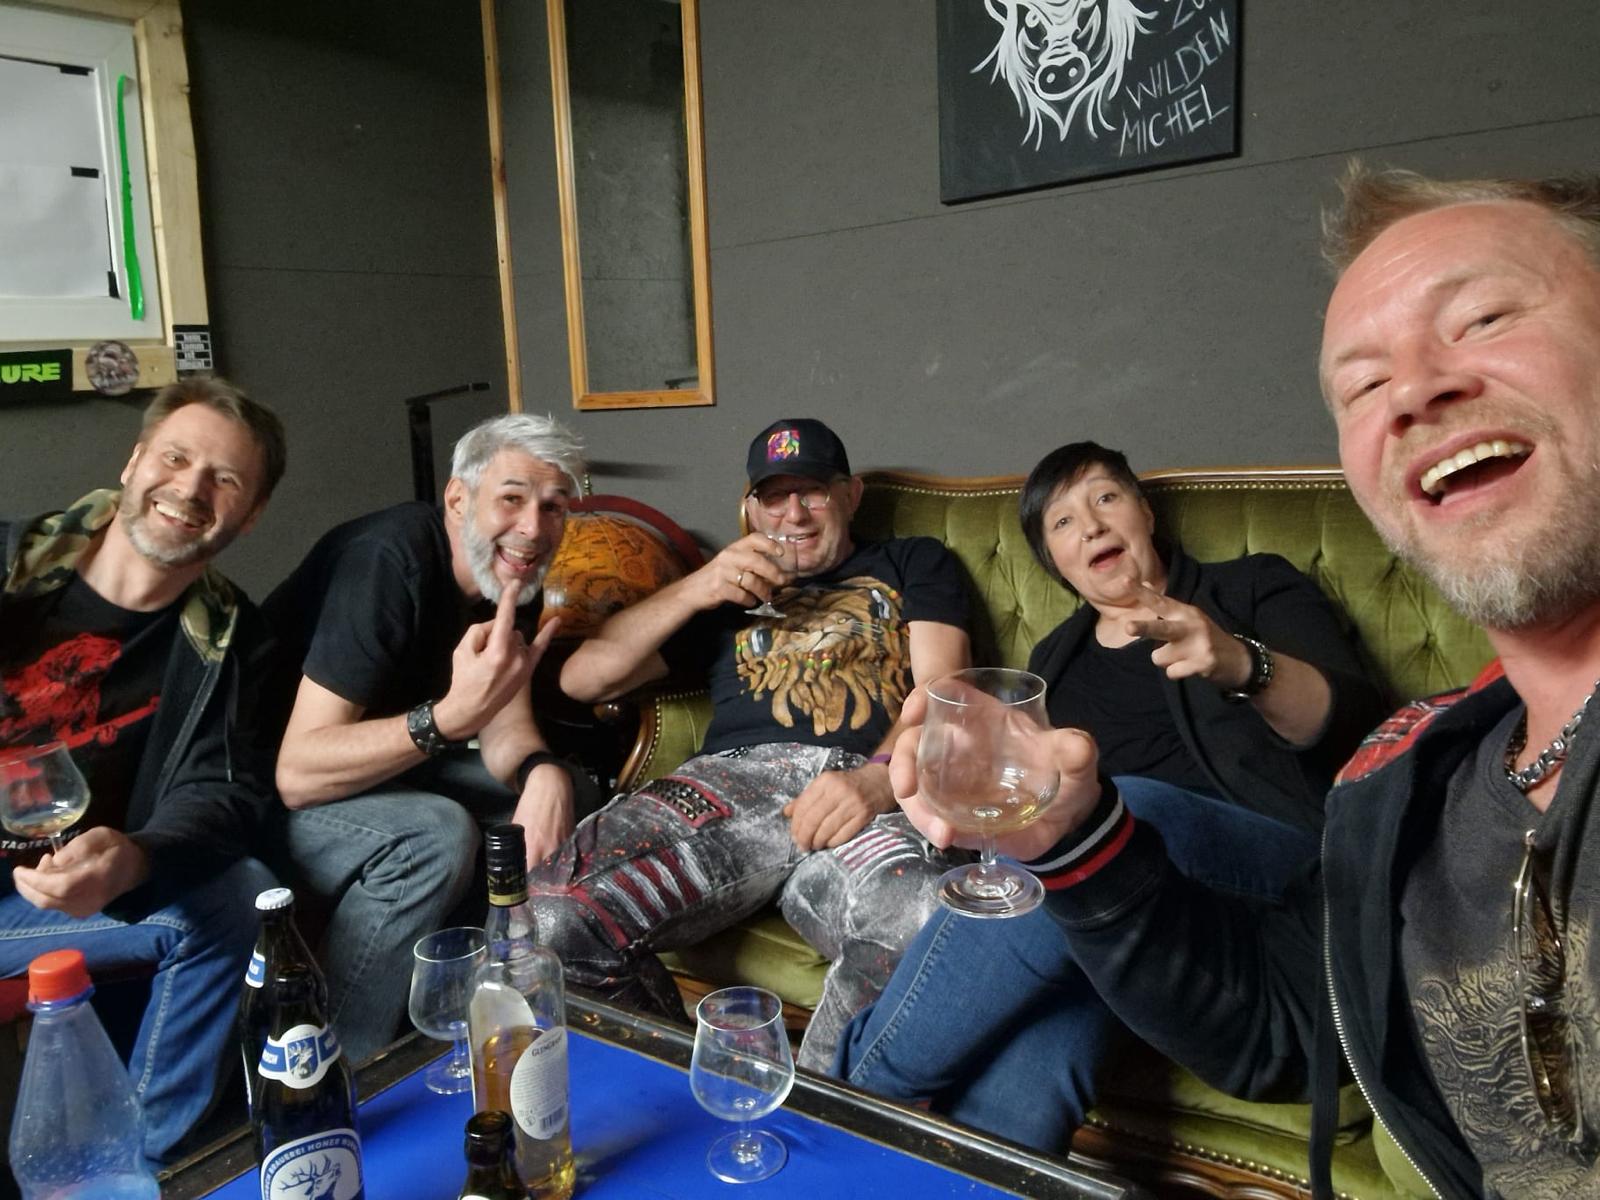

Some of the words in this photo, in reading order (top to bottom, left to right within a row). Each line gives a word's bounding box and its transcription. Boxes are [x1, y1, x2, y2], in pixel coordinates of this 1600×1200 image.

[1125, 8, 1230, 110] WILDEN
[1119, 83, 1231, 157] MICHEL
[0, 362, 62, 385] URE
